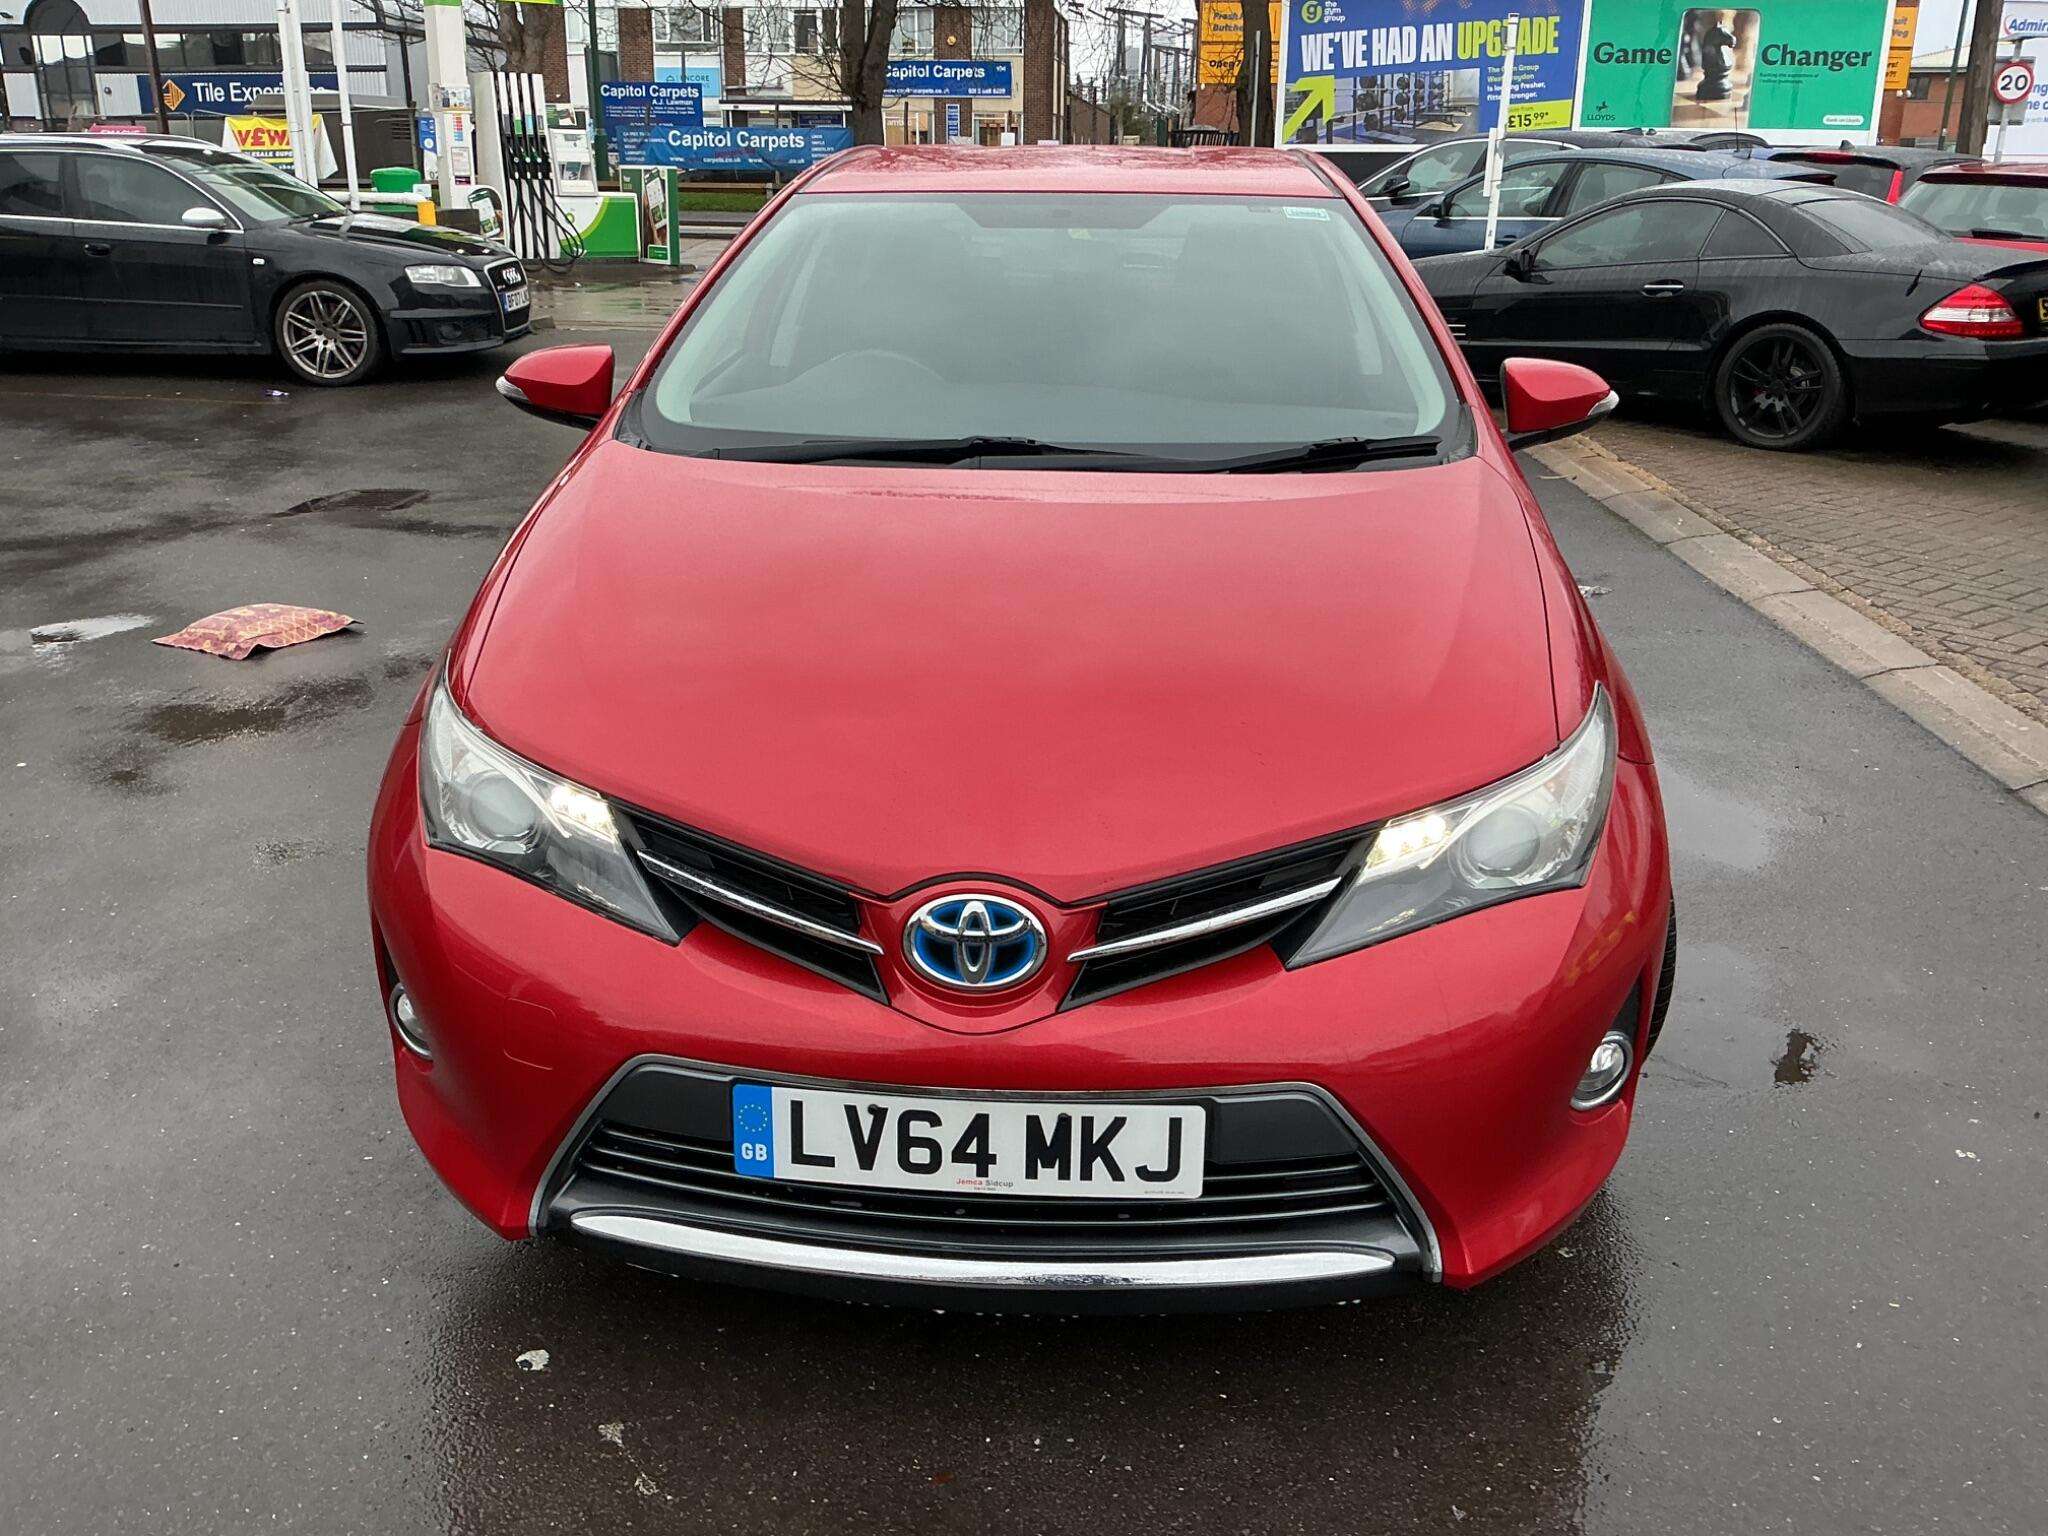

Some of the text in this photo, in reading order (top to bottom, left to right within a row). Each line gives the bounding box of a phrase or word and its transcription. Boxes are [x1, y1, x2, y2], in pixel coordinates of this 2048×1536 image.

[1324, 15, 1345, 23] group
[1301, 16, 1560, 72] WE'VE HAD AN UPGADE
[1594, 42, 1672, 64] Game
[1761, 44, 1872, 72] Changer
[933, 65, 985, 80] Carpets
[192, 82, 225, 102] Tile
[2000, 74, 2028, 91] 20
[600, 85, 700, 100] Capitol Carpets
[668, 130, 731, 151] Capitol
[736, 132, 805, 152] Carpets
[790, 1100, 1182, 1183] LV64 MKJ
[741, 1142, 767, 1161] GB
[956, 1178, 1014, 1188] Jemca Sidcup
